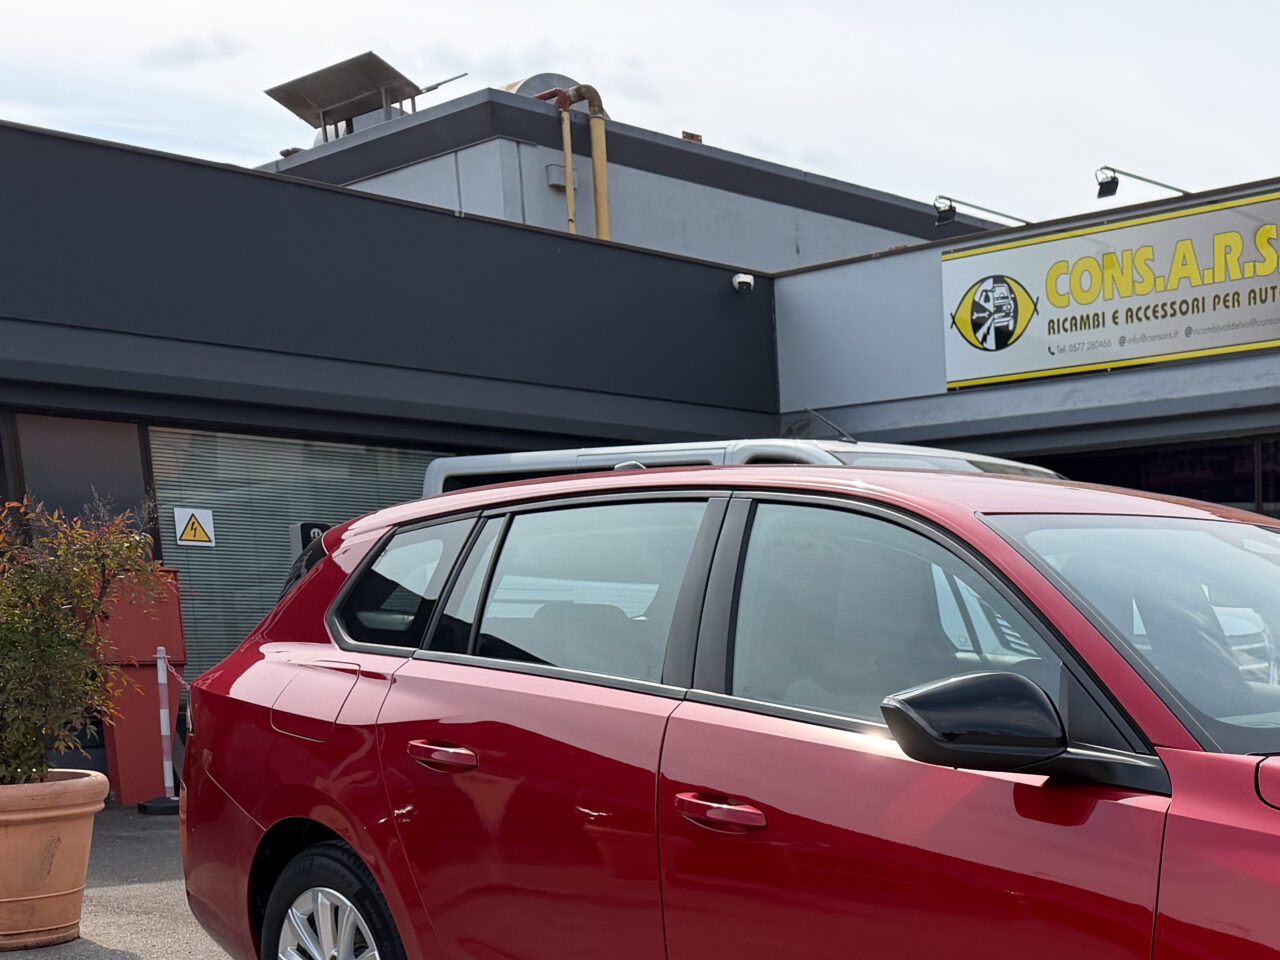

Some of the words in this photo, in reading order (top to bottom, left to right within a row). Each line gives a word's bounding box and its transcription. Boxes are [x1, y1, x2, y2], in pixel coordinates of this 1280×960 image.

[1047, 311, 1106, 336] RICAMBI
[1112, 309, 1119, 326] E
[1125, 299, 1206, 326] ACCESSORI
[1213, 291, 1241, 312] PER
